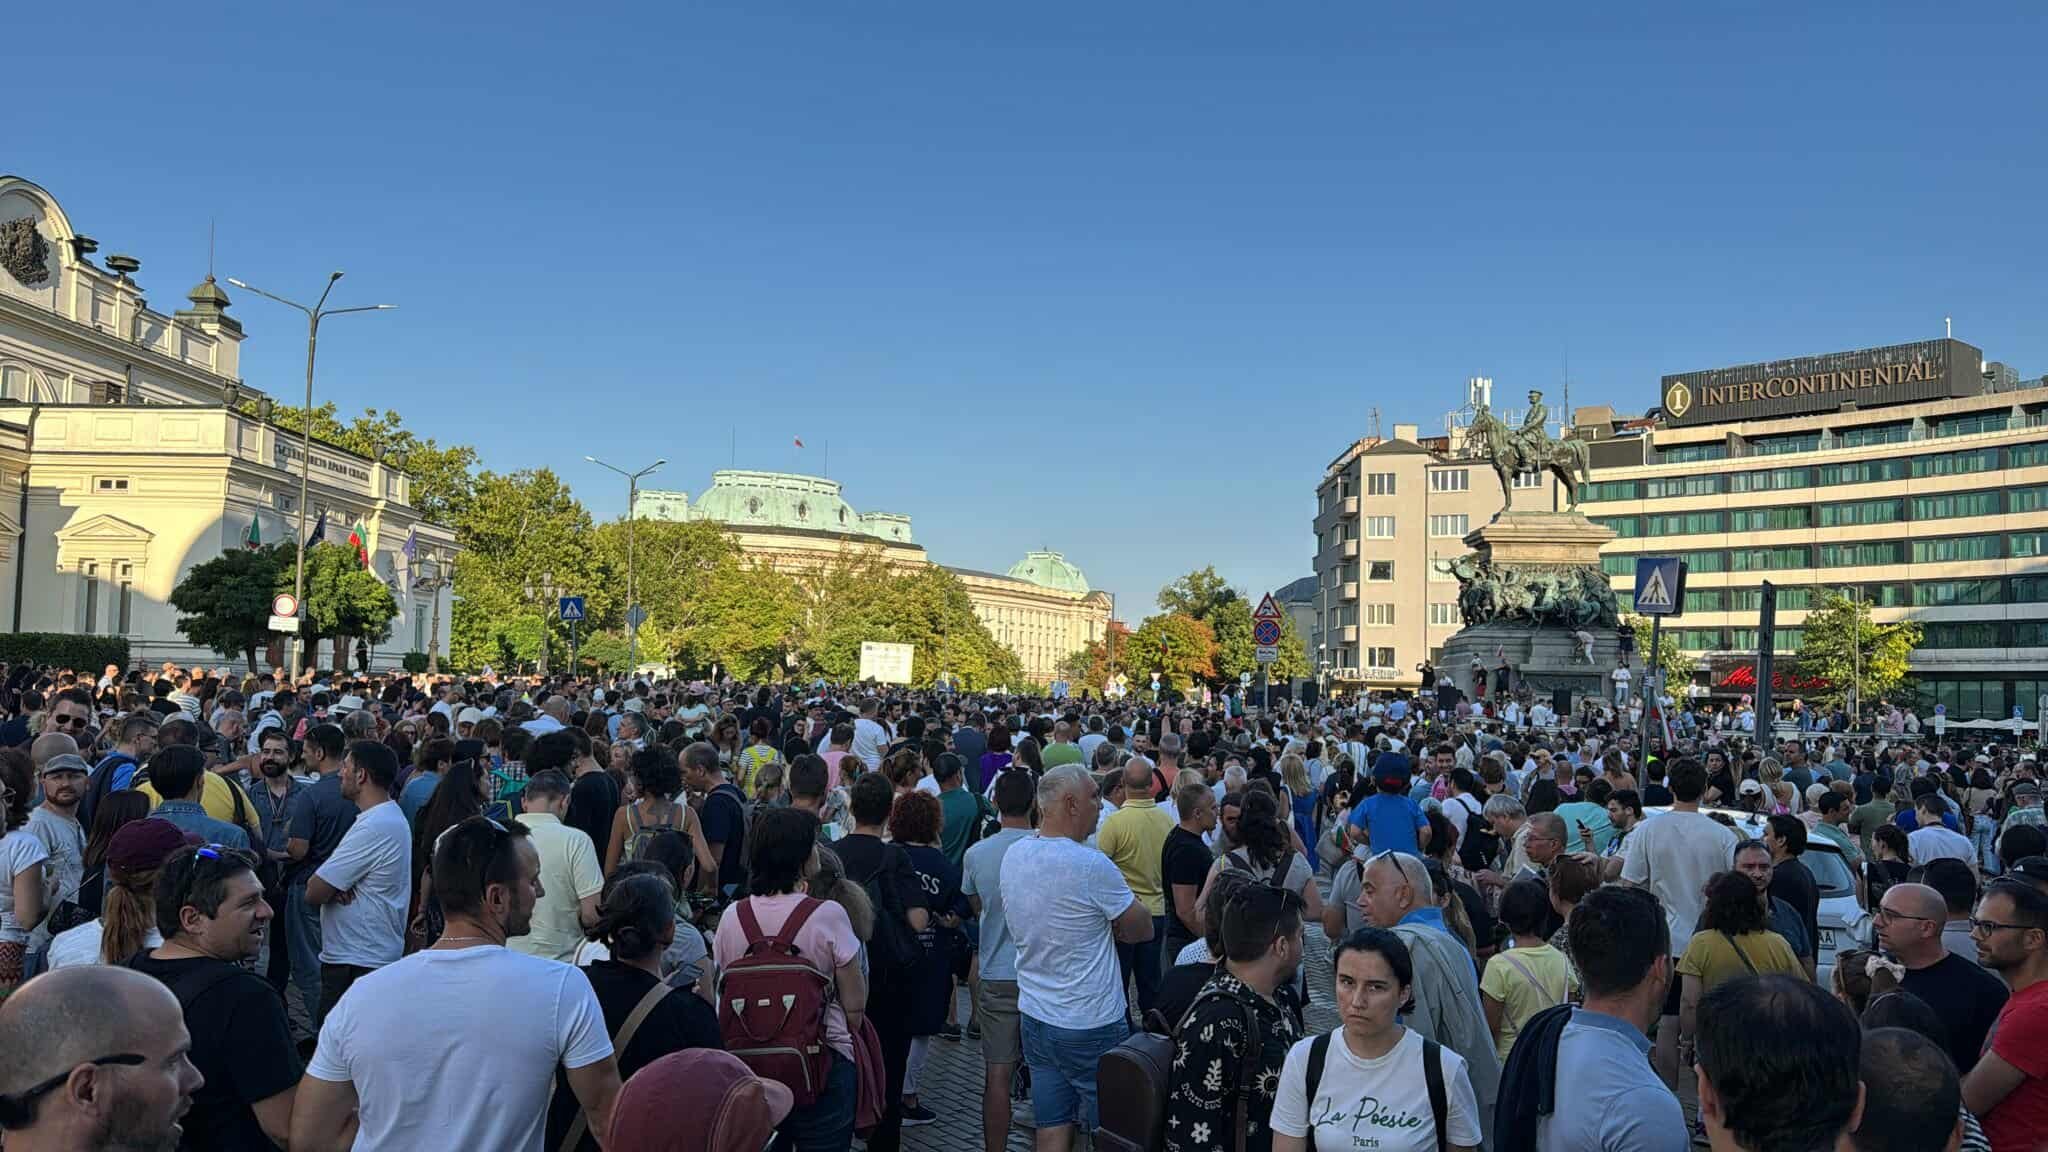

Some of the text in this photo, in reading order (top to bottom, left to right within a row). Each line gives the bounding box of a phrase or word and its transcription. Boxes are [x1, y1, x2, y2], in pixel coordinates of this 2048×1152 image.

[1700, 360, 1937, 407] INTERCONTINENTAL
[1316, 1096, 1347, 1127] La
[1352, 1135, 1380, 1148] Paris
